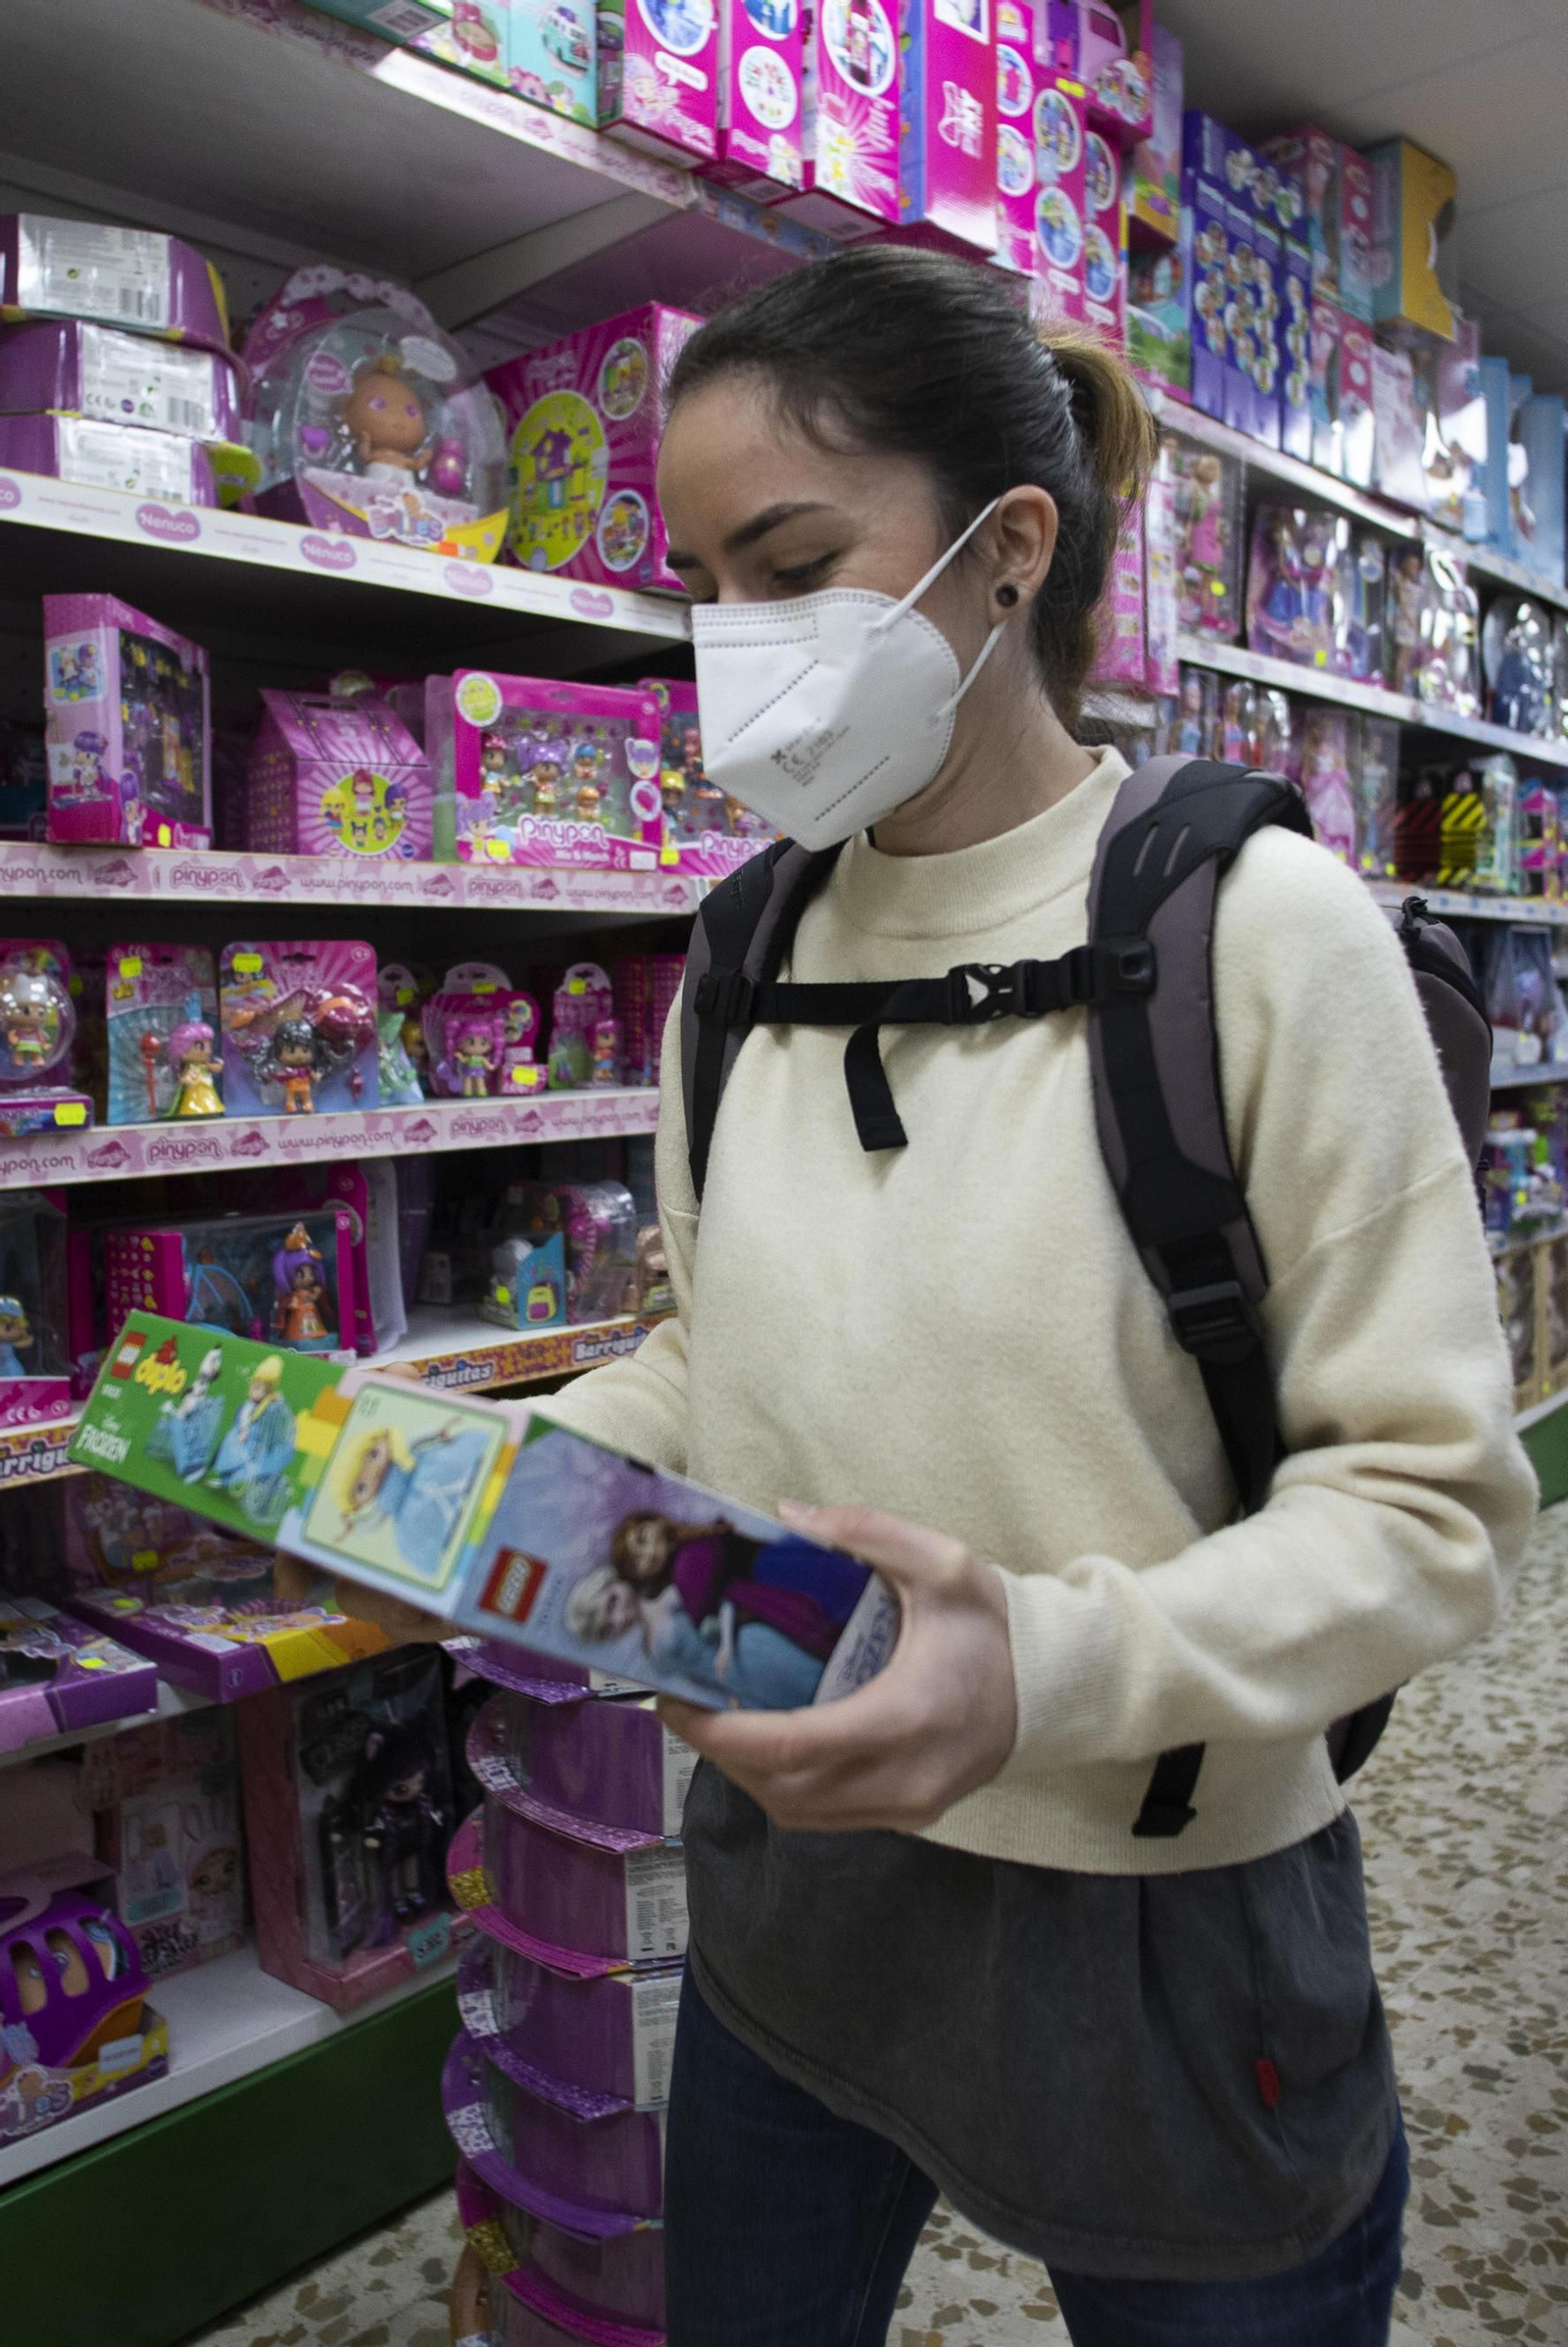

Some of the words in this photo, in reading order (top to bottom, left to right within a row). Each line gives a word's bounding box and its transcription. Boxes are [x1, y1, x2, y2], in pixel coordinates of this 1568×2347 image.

[139, 506, 195, 534] Nenuco
[303, 540, 353, 563] Nenuco
[518, 813, 610, 850] Pinypon
[171, 862, 245, 889] pinypon
[300, 875, 416, 896] www.pinypon.com
[467, 877, 523, 901] pinypon
[149, 1137, 223, 1164] pinypon
[278, 1131, 394, 1150] www.pinypon.com
[450, 1115, 508, 1138] pinypon
[75, 1423, 132, 1463] FROZEN
